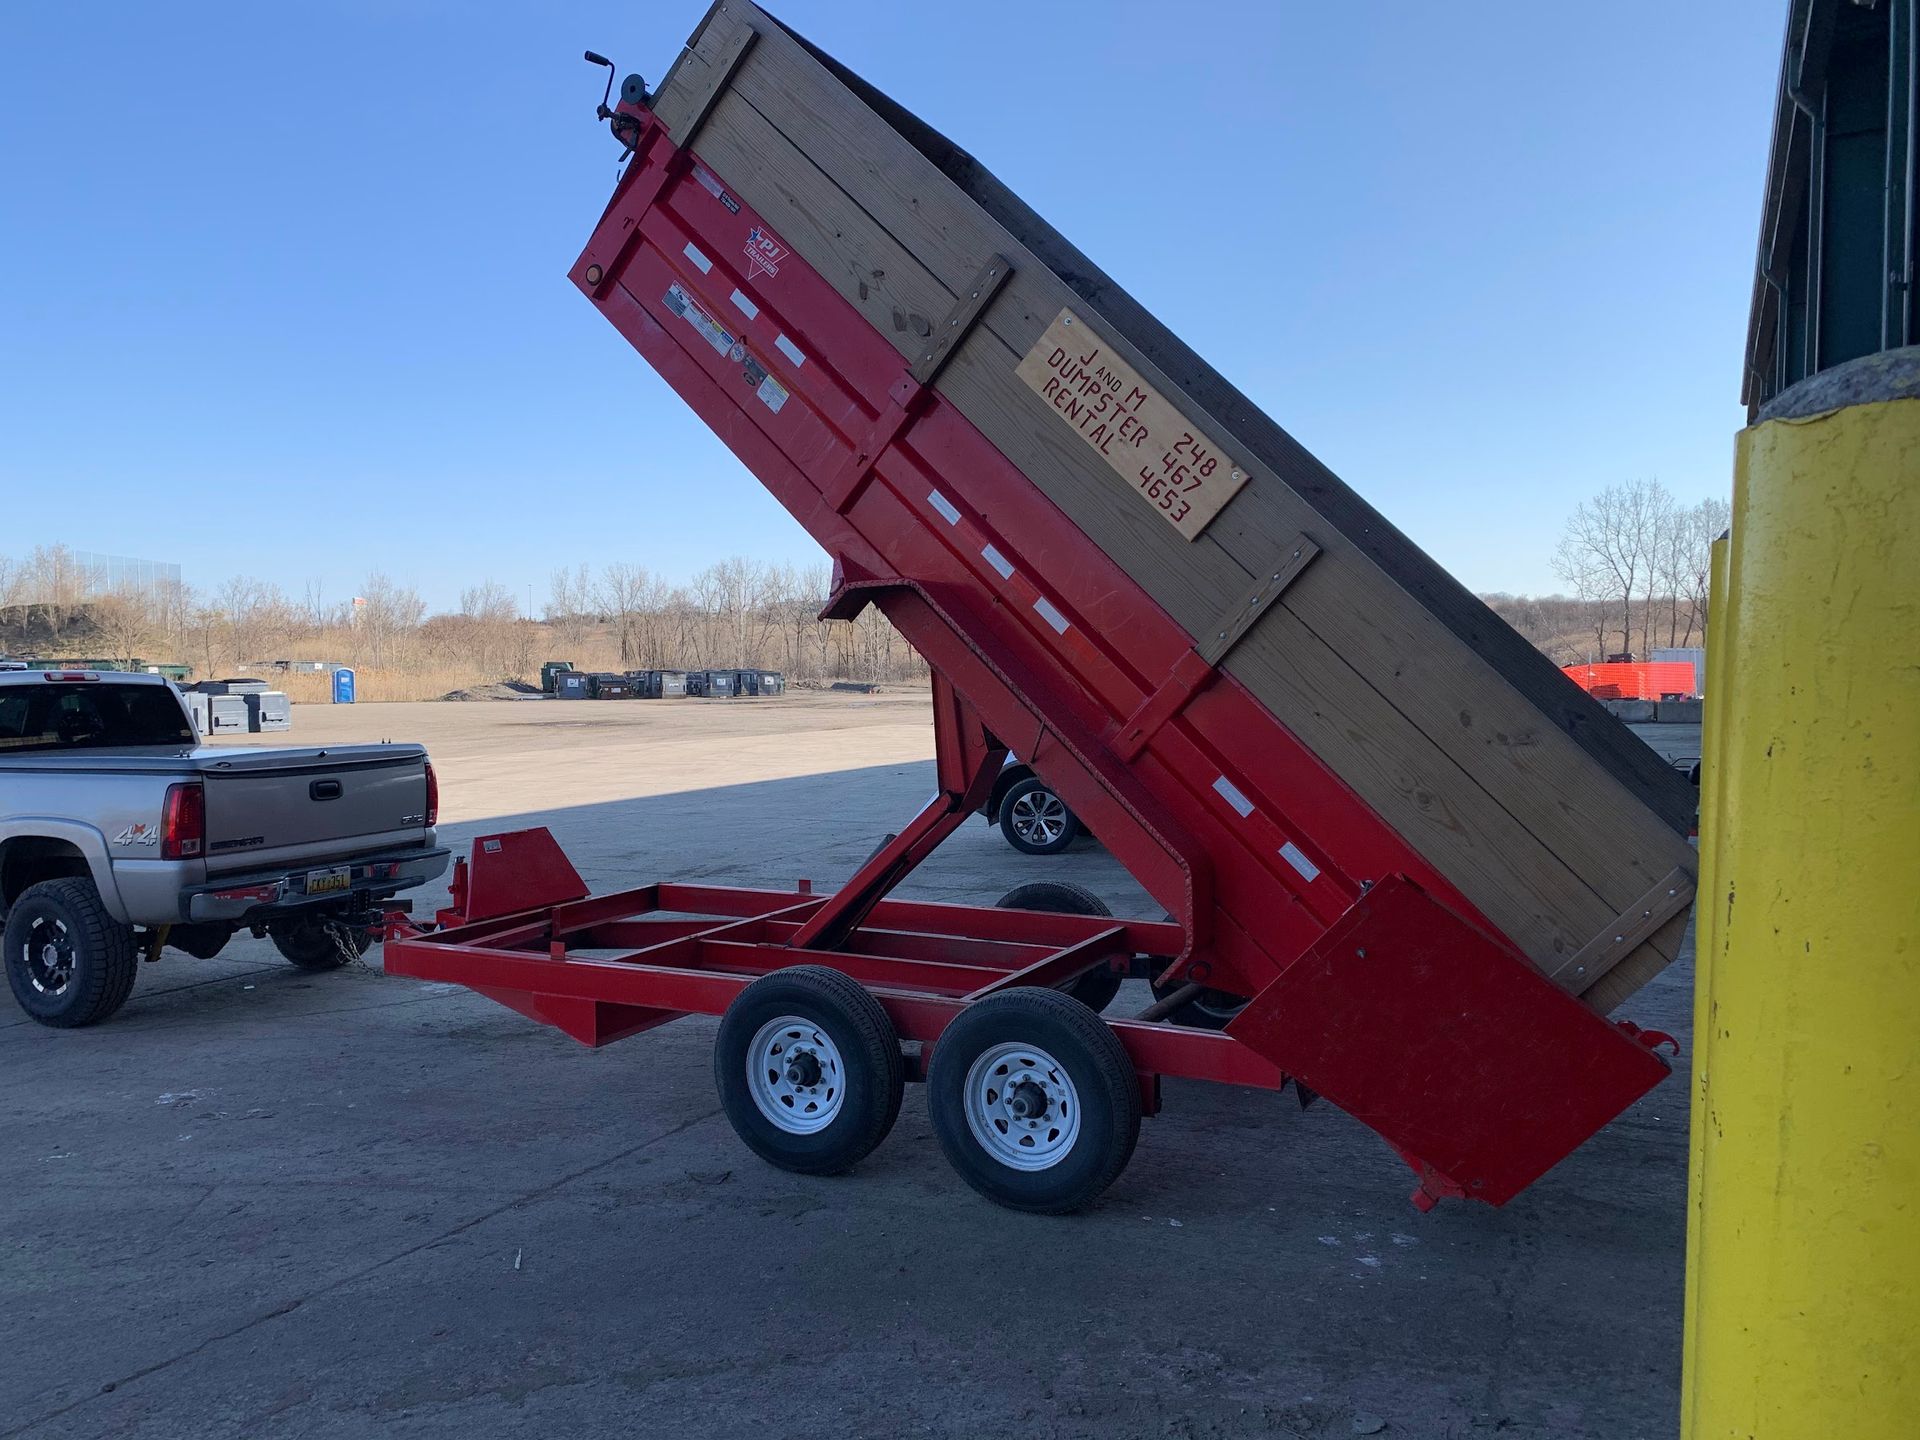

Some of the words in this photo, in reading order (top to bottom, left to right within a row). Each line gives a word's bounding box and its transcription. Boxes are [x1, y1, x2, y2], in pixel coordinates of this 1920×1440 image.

[746, 246, 777, 274] TRAILERS
[759, 238, 780, 258] PJ
[1047, 347, 1149, 448] DUMPSTER
[1079, 349, 1099, 366] J
[1095, 366, 1123, 393] AND
[1124, 386, 1147, 412] M
[1042, 376, 1116, 456] RENTAL
[1161, 452, 1203, 493] 467
[1172, 432, 1218, 478] 248
[1139, 465, 1192, 523] 4653
